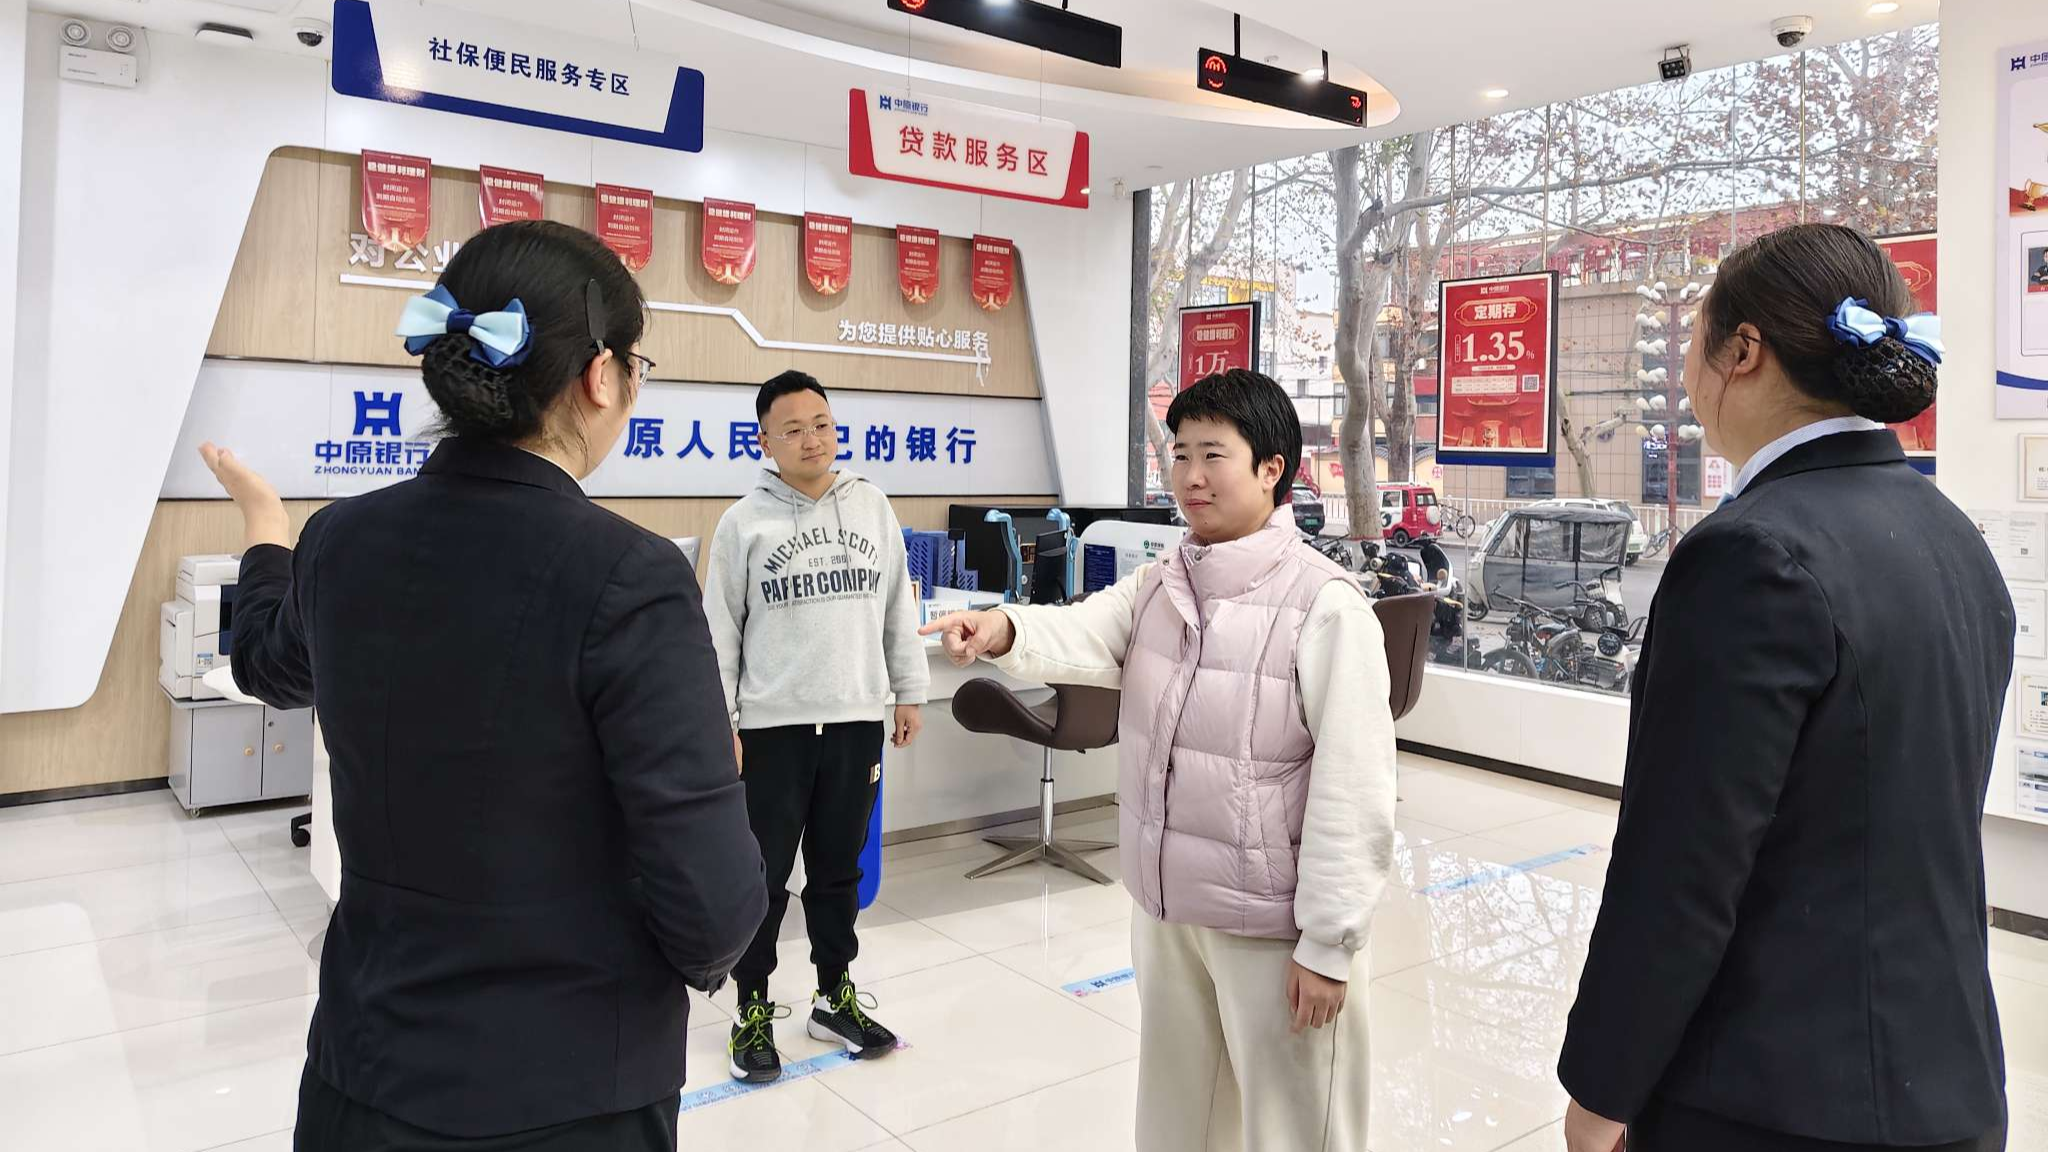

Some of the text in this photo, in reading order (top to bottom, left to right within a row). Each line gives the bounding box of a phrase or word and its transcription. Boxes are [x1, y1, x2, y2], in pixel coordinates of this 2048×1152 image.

[428, 36, 631, 96] 社保便民服务专区
[899, 125, 1049, 177] 贷款服务区
[1474, 303, 1517, 320] 定期存
[838, 319, 990, 351] 为您提供贴心服务
[1195, 350, 1241, 377] 1万
[315, 440, 431, 465] 中原银行
[314, 465, 392, 475] ZHONGYUAN
[764, 527, 879, 575] MICHAEL SCOTT
[760, 573, 815, 604] PAPER
